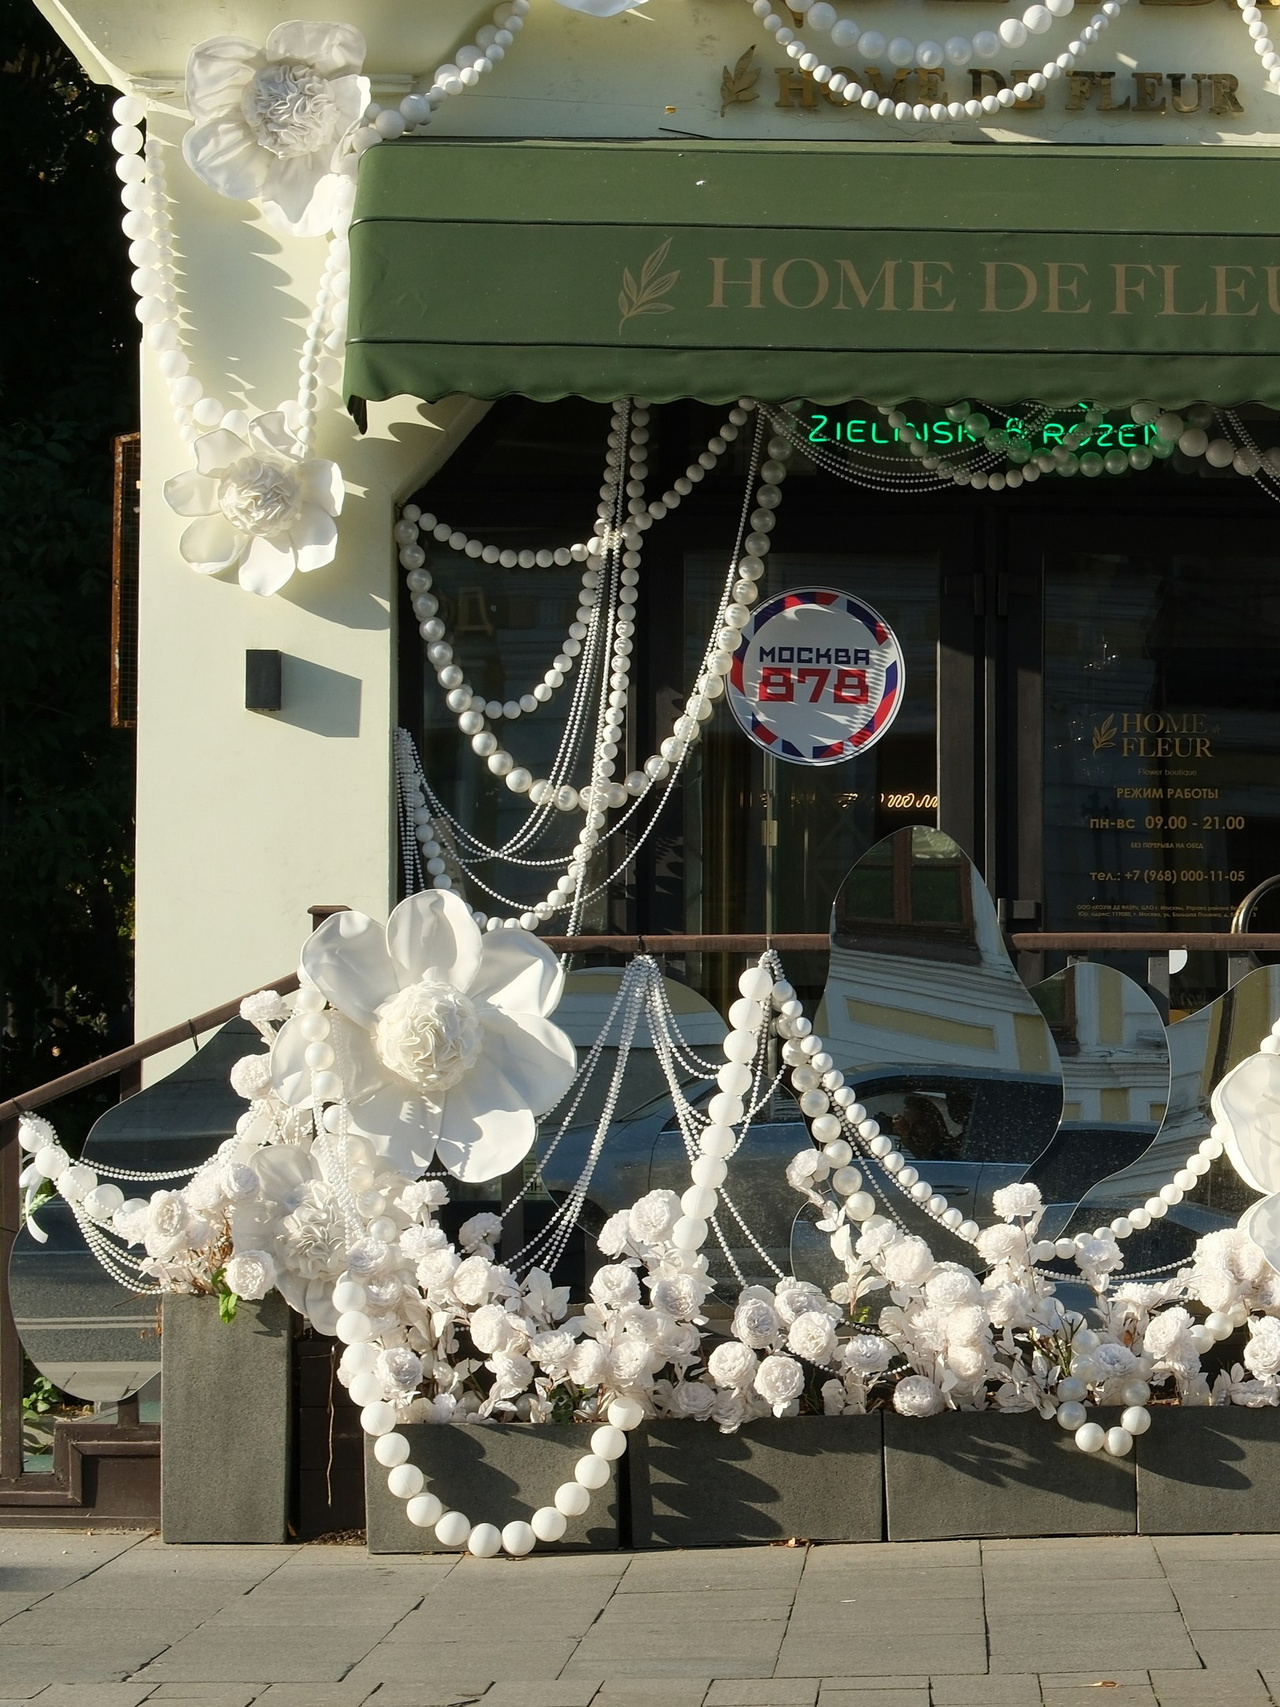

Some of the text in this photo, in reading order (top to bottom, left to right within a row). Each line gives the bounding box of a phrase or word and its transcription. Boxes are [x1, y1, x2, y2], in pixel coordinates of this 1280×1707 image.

[774, 66, 1245, 114] HOME DE FLEUR
[706, 256, 956, 312] HOME
[978, 261, 1091, 314] DE
[759, 646, 870, 665] МОСКВА
[759, 667, 869, 704] 878
[1121, 712, 1208, 734] HOME
[1121, 737, 1214, 758] FLEUR
[1137, 768, 1198, 778] Flower boutique
[1116, 788, 1219, 799] РЕЖИМ РАБОТЫ
[1145, 816, 1188, 830] 09.00
[1202, 816, 1245, 830] 21.00
[1090, 869, 1245, 884] тел.: +7 (968) 000-11-05
